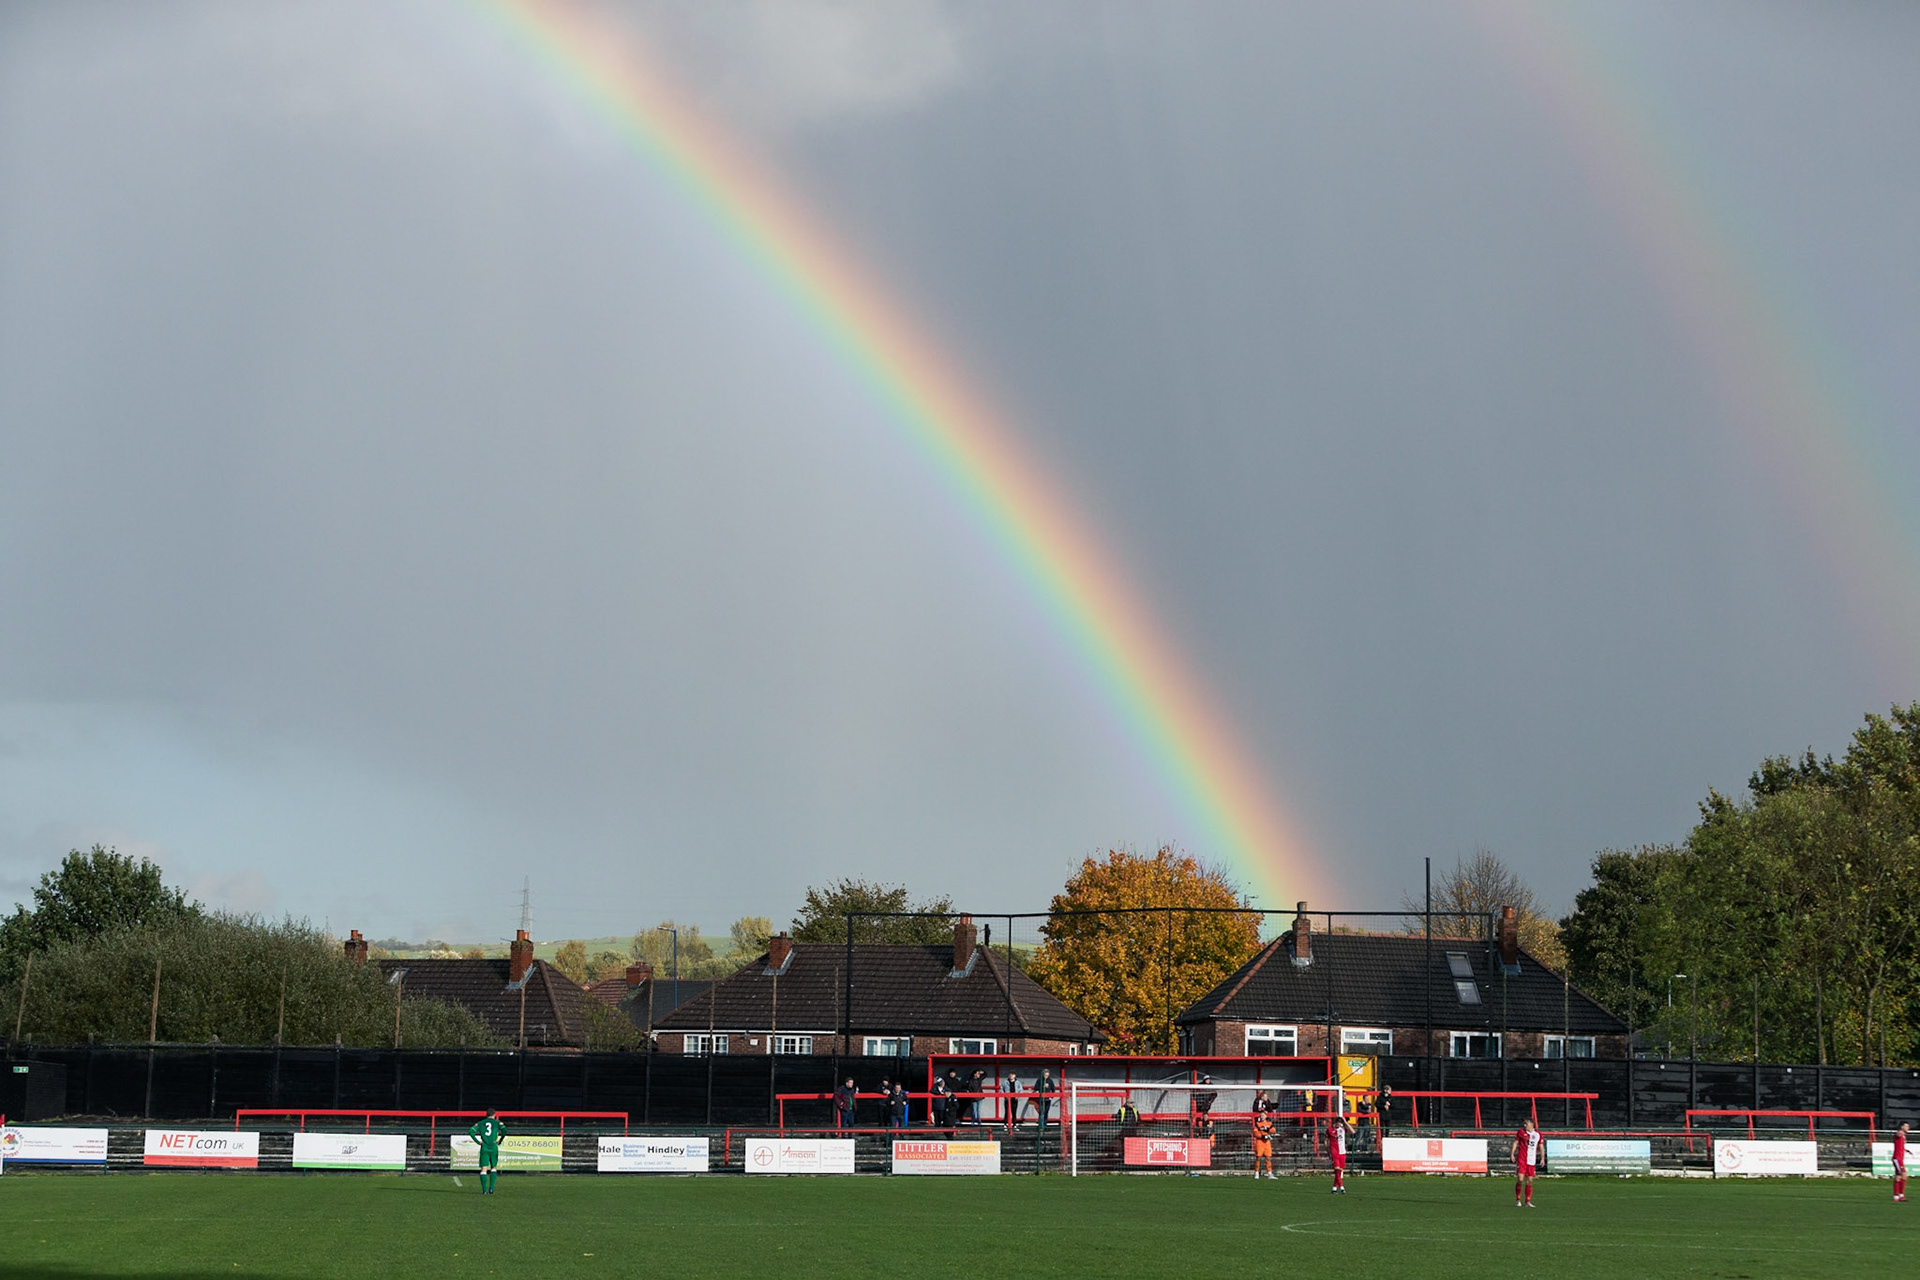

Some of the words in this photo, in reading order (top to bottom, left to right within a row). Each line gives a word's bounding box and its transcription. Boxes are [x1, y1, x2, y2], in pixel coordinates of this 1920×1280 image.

[485, 1122, 492, 1136] 3
[159, 1133, 228, 1150] NETcom
[232, 1142, 245, 1150] UK
[508, 1140, 531, 1148] 01457
[598, 1145, 621, 1153] Hale
[647, 1146, 685, 1155] Hindley
[898, 1143, 945, 1153] LITTLER
[1153, 1142, 1183, 1152] PITCHING
[1166, 1152, 1174, 1160] IN
